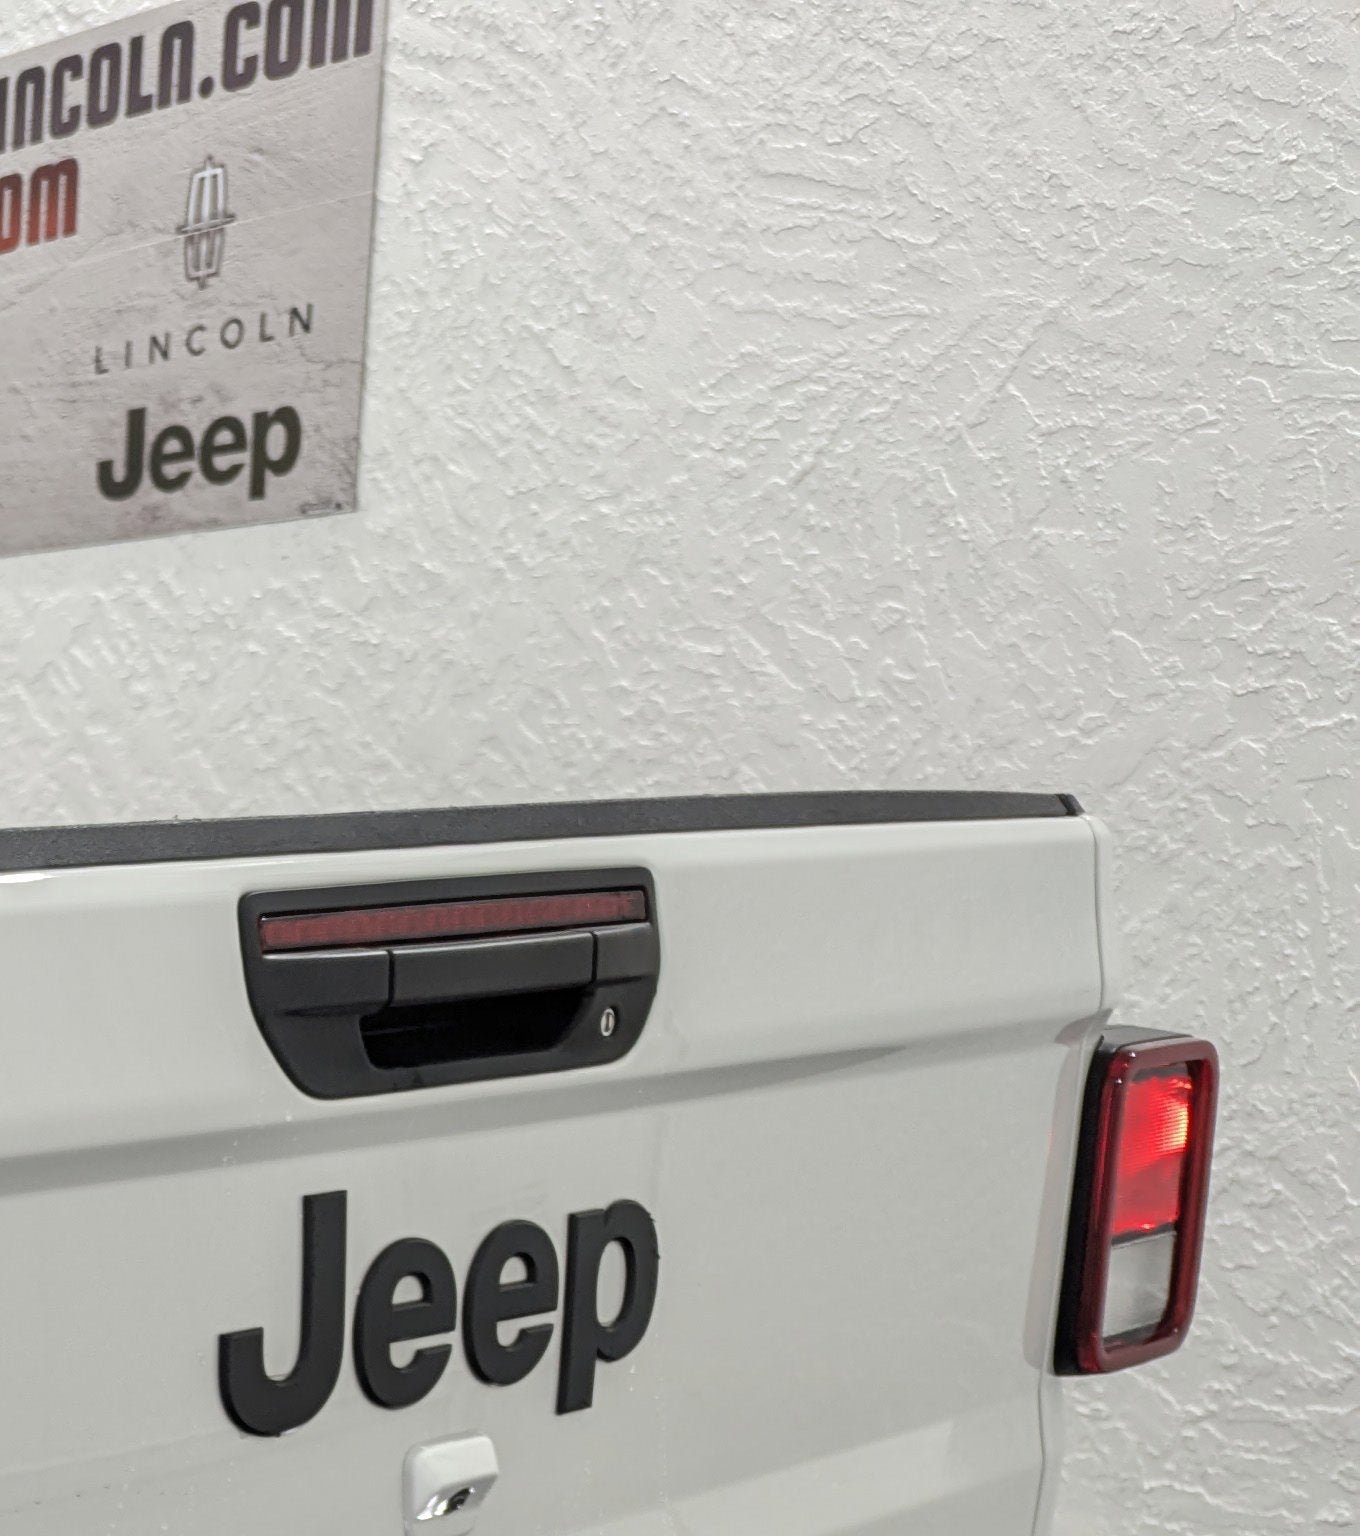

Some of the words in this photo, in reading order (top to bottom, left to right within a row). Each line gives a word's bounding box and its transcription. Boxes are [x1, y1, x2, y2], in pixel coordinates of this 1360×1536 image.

[93, 303, 315, 375] LINCOLN
[95, 405, 302, 501] Jeep
[218, 1189, 660, 1438] Jeep
